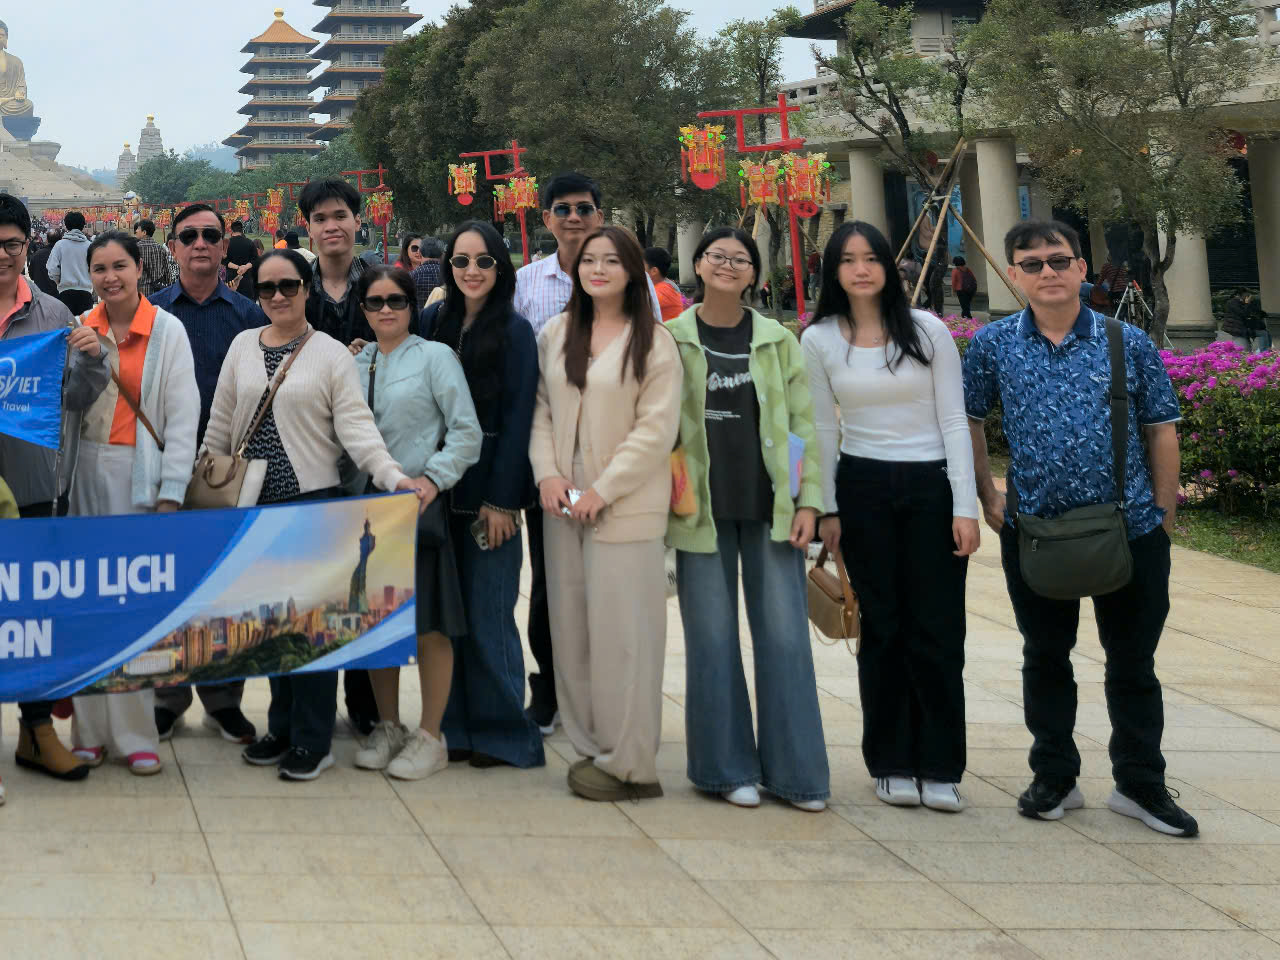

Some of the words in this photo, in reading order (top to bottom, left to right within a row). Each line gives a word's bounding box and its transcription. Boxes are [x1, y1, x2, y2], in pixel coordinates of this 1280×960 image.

[2, 401, 30, 412] Travel
[32, 560, 85, 600] DU
[98, 554, 175, 605] LỊCH
